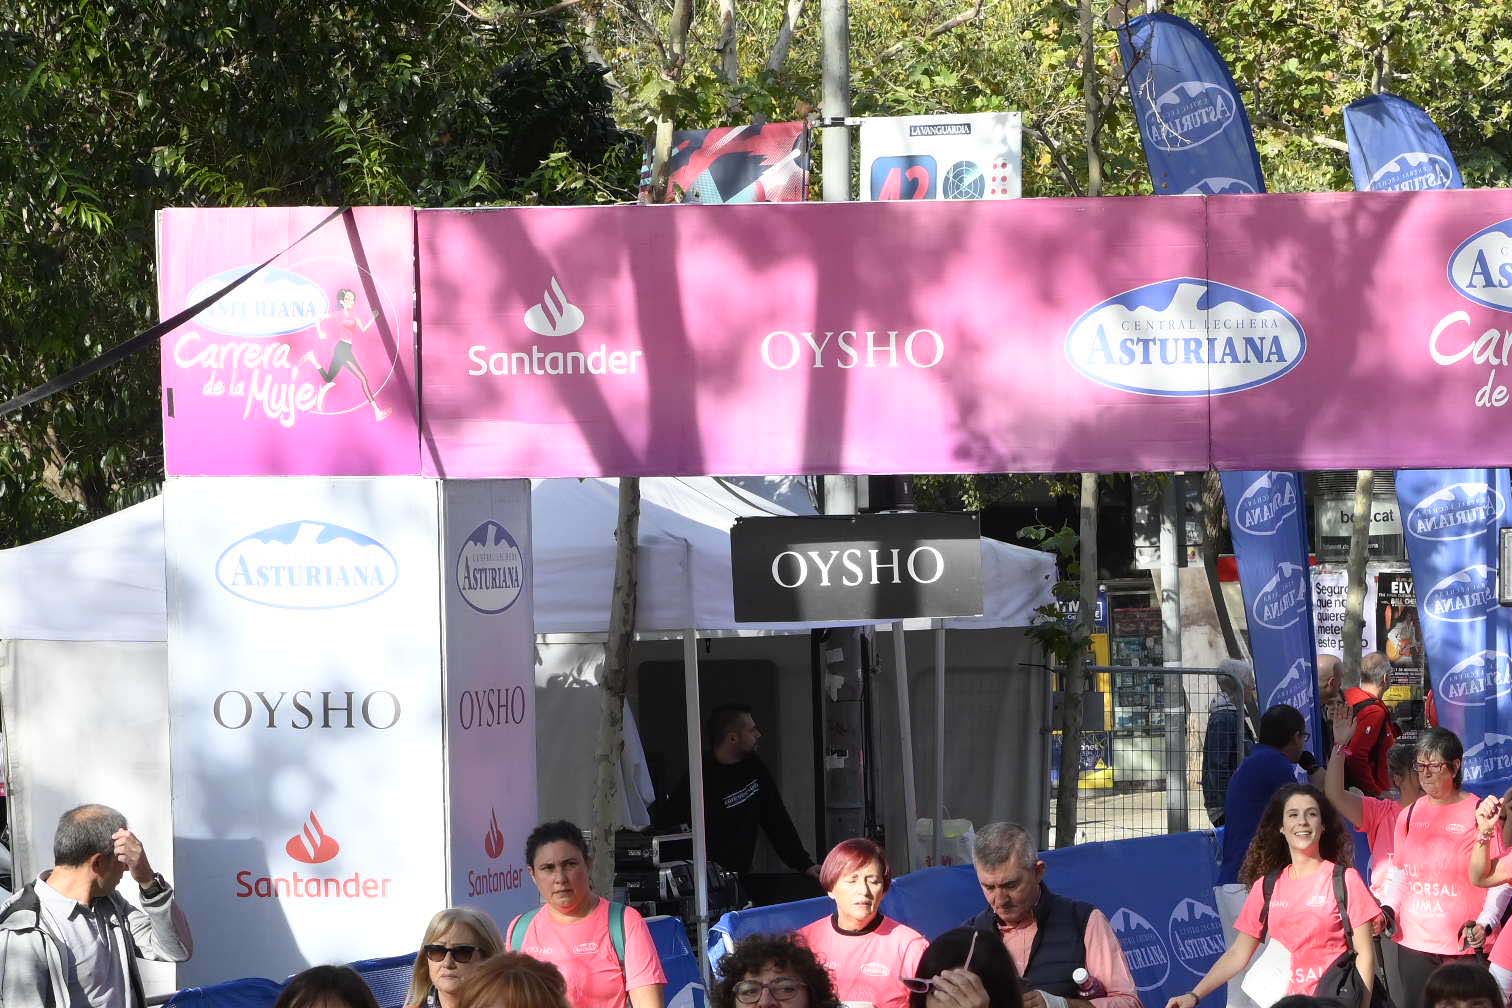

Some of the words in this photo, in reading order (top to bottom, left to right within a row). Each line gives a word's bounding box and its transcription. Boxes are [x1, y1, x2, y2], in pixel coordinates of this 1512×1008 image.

[1121, 319, 1197, 332] CENTRAL
[1204, 318, 1280, 330] LECHERA
[173, 331, 291, 368] Carrera
[468, 345, 642, 377] Santander
[761, 329, 945, 370] OYSHO
[1086, 323, 1288, 366] ASTURIANA
[203, 370, 224, 396] de
[230, 368, 245, 396] la
[242, 366, 337, 428] Mujer
[1475, 369, 1509, 407] de
[230, 554, 386, 588] ASTURIANA
[462, 555, 520, 592] ASTURIANA
[771, 545, 945, 588] OYSHO
[1316, 598, 1332, 610] que
[1317, 637, 1337, 649] este
[213, 690, 401, 730] OYSHO
[459, 685, 526, 730] OYSHO
[236, 870, 392, 899] Santander
[468, 865, 524, 898] Santander
